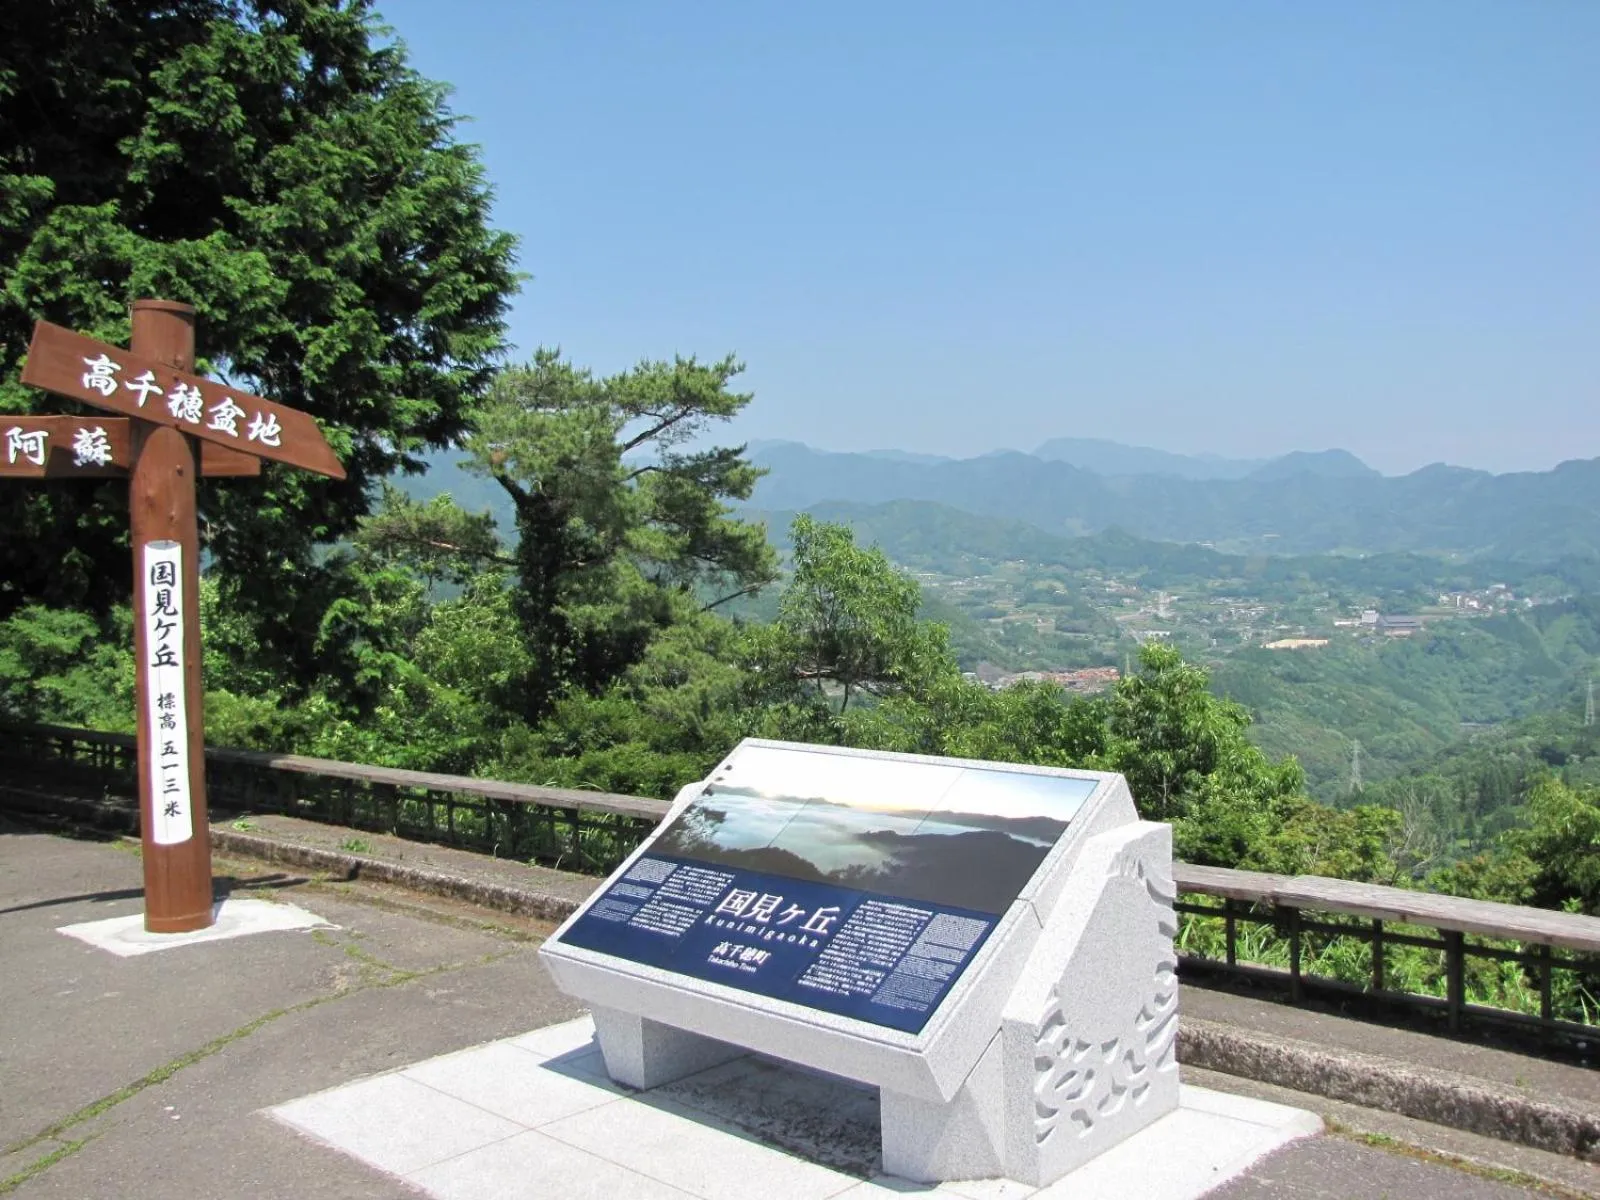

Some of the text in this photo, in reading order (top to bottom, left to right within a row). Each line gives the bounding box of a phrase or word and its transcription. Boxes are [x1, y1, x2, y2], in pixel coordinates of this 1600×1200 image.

[81, 353, 283, 447] 高千穂盆地
[704, 915, 819, 948] Kunimigaoka
[712, 941, 772, 966] 高千穂町
